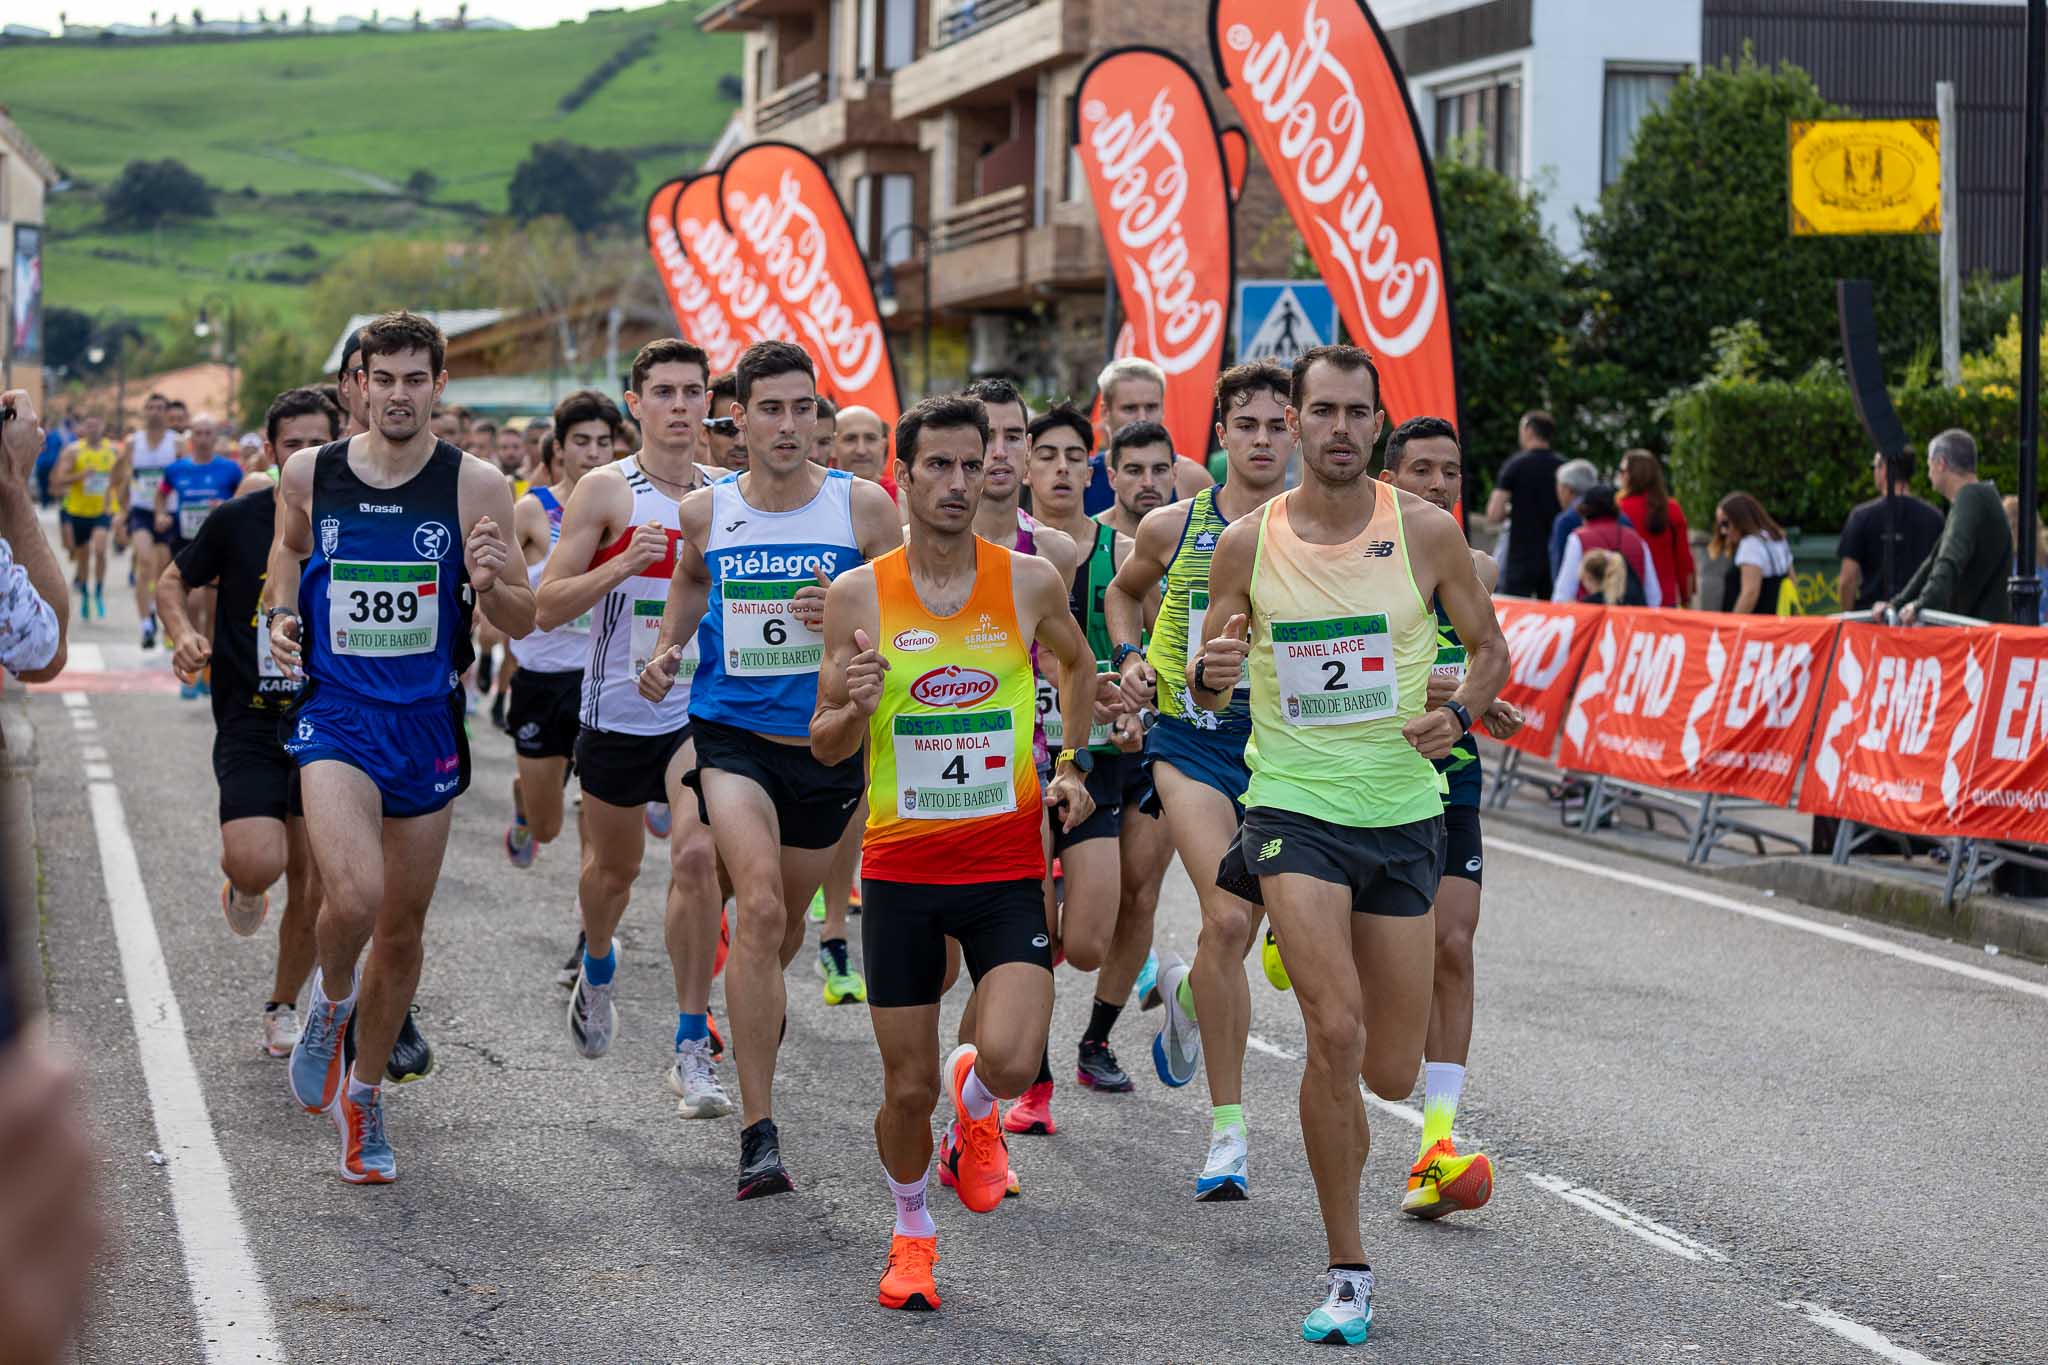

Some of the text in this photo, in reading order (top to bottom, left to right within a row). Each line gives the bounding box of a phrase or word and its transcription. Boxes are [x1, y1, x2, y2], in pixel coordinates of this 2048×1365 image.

[336, 567, 431, 581] COSTA DE AJO
[728, 585, 787, 600] COSTA DE
[349, 590, 418, 623] 389
[732, 602, 784, 615] SANTIAGO
[349, 631, 427, 647] AYTO DE BAREYO
[763, 619, 787, 646] 6
[1276, 618, 1380, 641] COSTA DE AJO
[898, 637, 935, 648] Serrano
[1288, 638, 1366, 658] DANIEL ARCE
[741, 649, 821, 666] AYTO DE BAREYO
[1321, 661, 1349, 691] 2
[1431, 666, 1460, 677] ASSEM
[918, 680, 991, 699] Serrano
[1301, 691, 1387, 715] AYTO DE BAREYO
[898, 715, 1006, 735] COSTA DE AJO
[915, 735, 991, 751] MARIO MOLA
[941, 754, 970, 784] 4
[918, 787, 1003, 808] AYTO DE BAREYO
